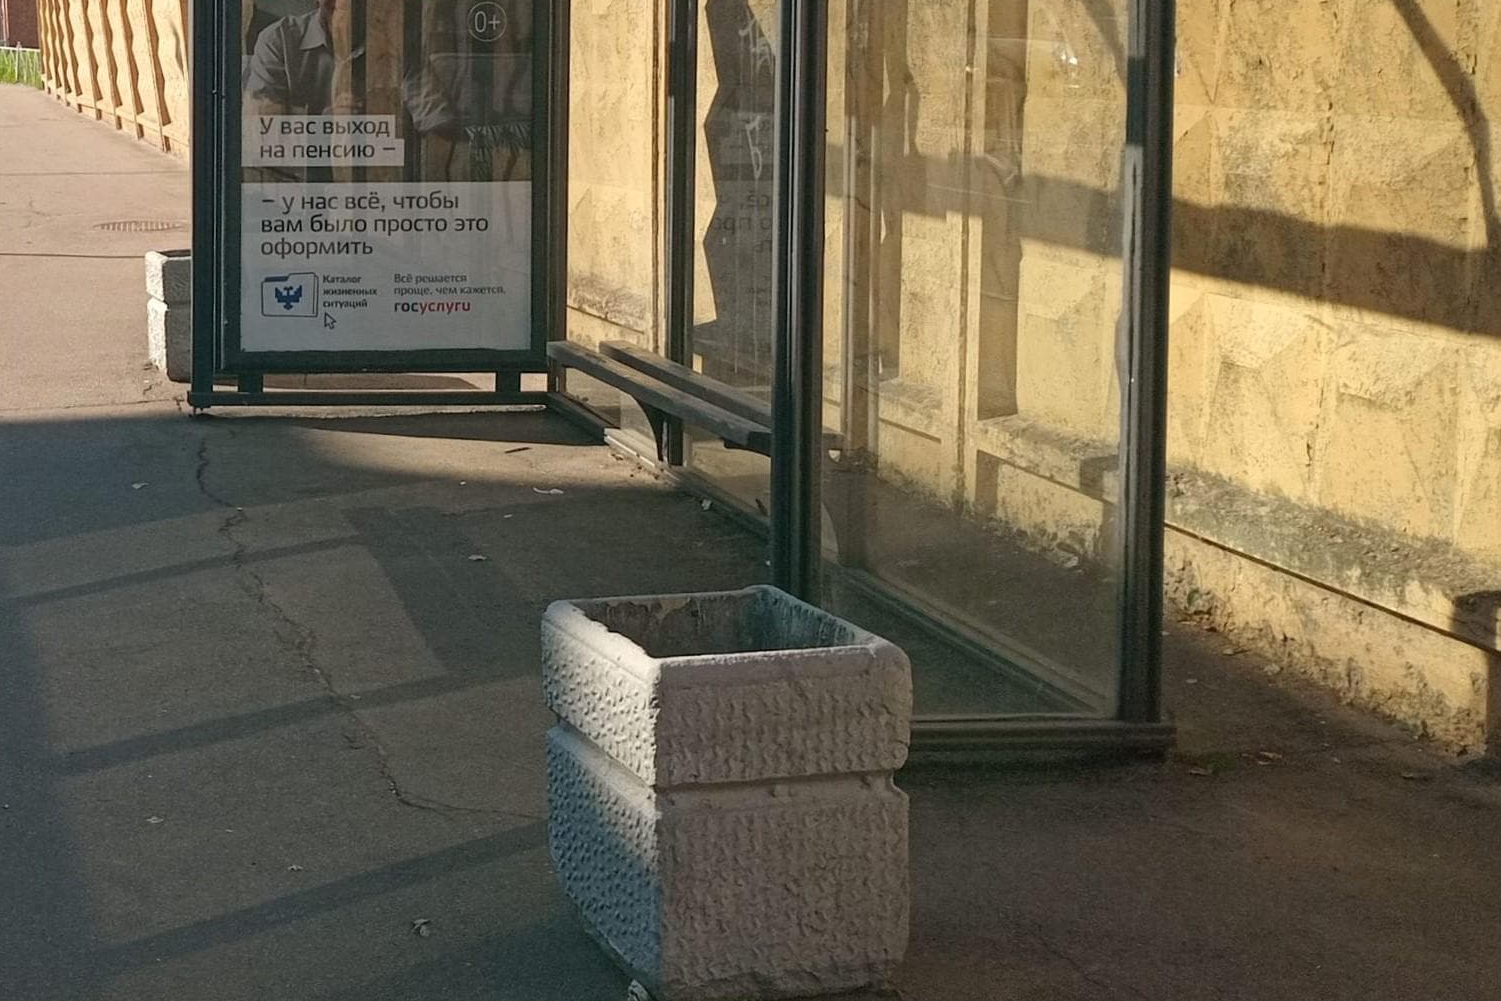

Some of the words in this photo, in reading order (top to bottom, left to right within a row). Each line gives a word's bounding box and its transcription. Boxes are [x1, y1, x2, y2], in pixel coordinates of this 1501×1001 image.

[474, 10, 501, 33] 0+
[259, 117, 274, 135] У
[280, 120, 316, 135] вас
[322, 120, 390, 138] выход
[259, 144, 285, 159] на
[292, 144, 375, 159] пенсию
[282, 196, 295, 214] у
[301, 195, 339, 210] нас
[344, 192, 385, 212] всё,
[393, 190, 459, 210] чтобы
[261, 218, 303, 233] вам
[310, 214, 367, 233] было
[374, 217, 447, 236] просто
[454, 217, 489, 232] это
[261, 237, 374, 259] оформить
[323, 275, 362, 283] Каталог
[394, 273, 413, 283] Всё
[415, 274, 467, 284] решается
[323, 288, 378, 296] жизненных
[435, 286, 457, 295] чем
[323, 299, 368, 309] ситуаций
[394, 301, 471, 315] госуслуги
